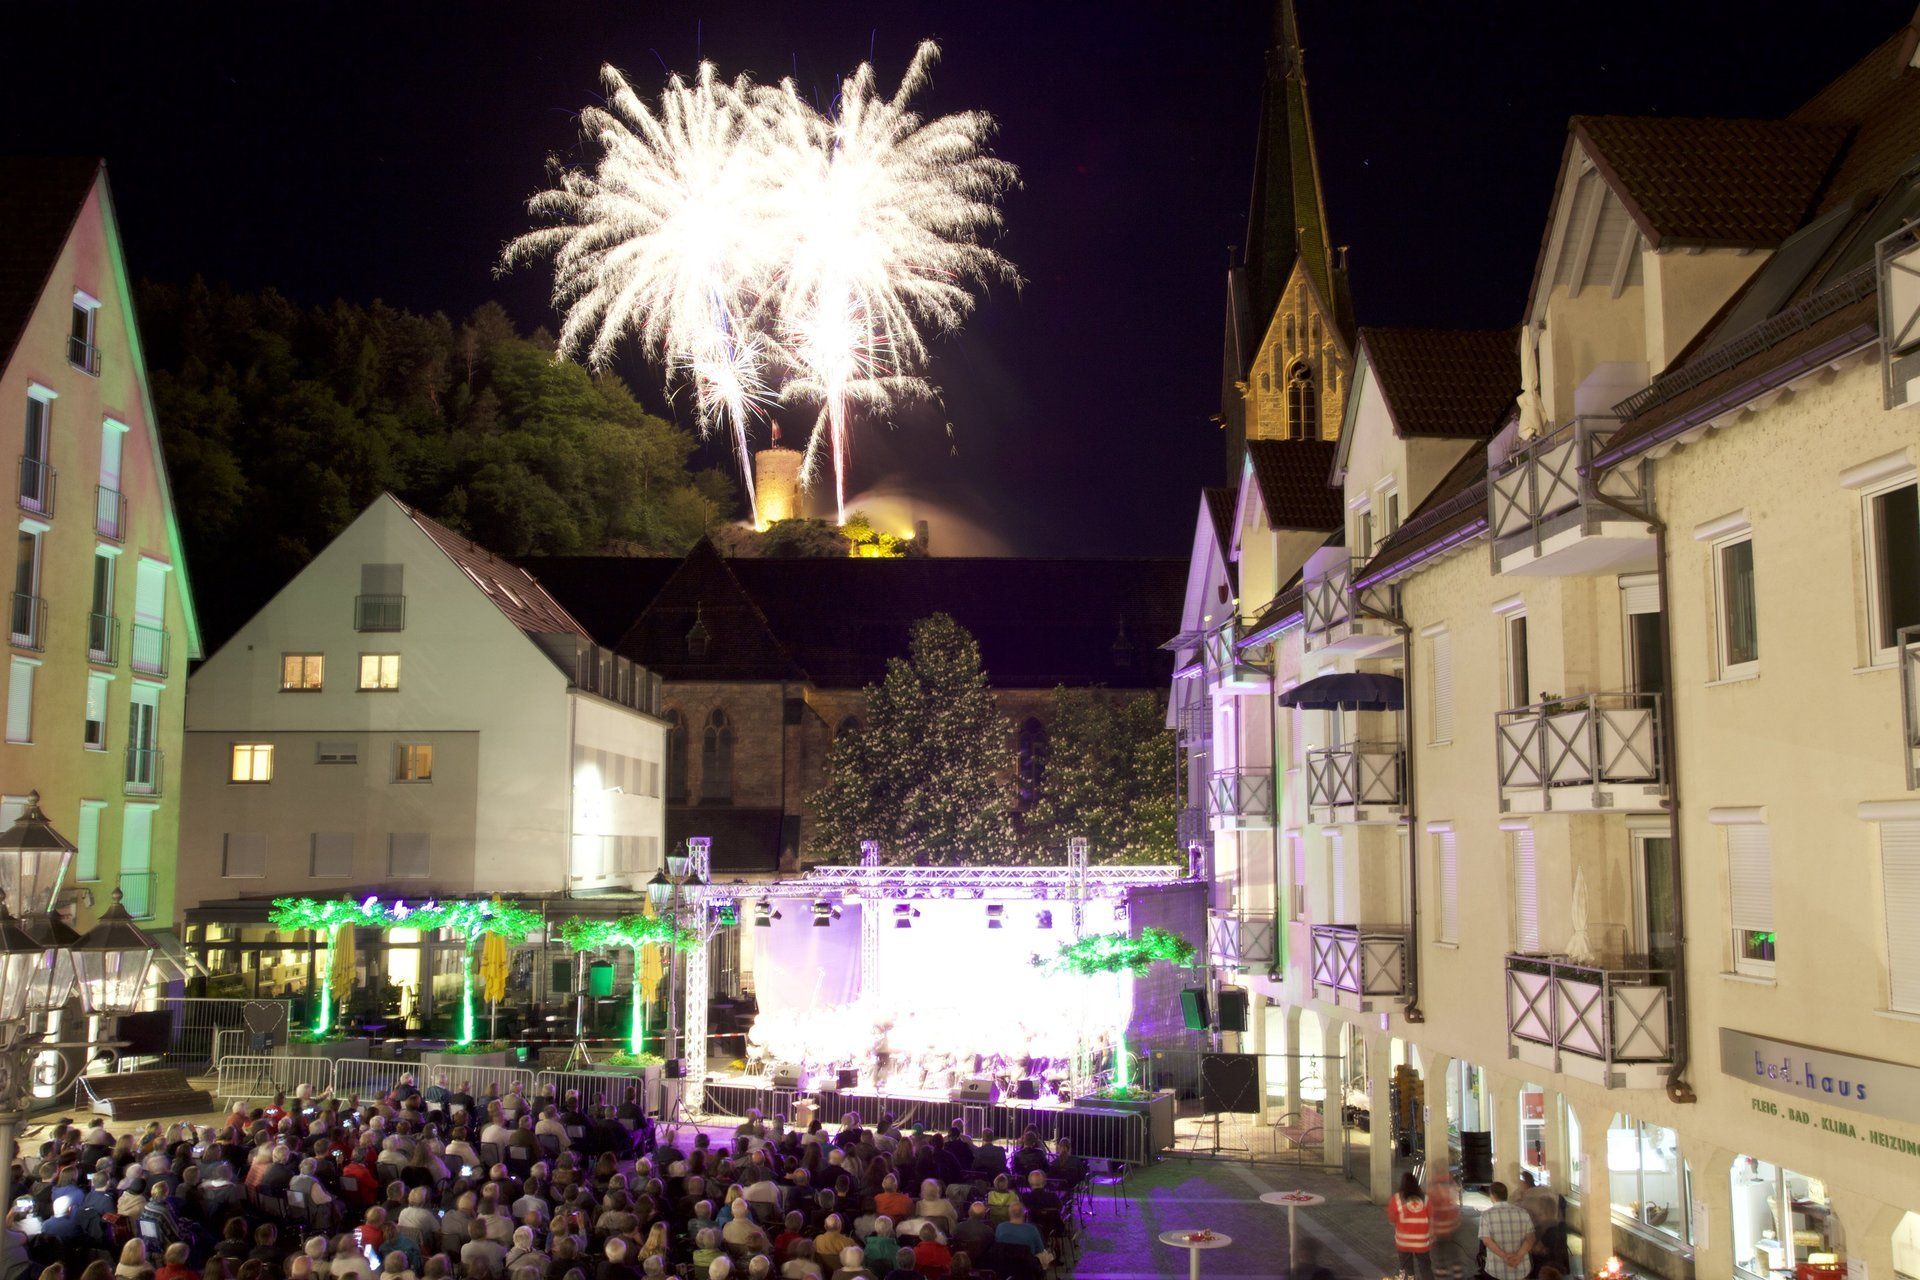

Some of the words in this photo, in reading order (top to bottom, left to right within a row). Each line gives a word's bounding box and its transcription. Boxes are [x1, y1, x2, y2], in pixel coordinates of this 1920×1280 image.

[1752, 1098, 1777, 1116] FLEIG
[1788, 1108, 1810, 1125] BAD
[1821, 1117, 1857, 1139] KLIMA
